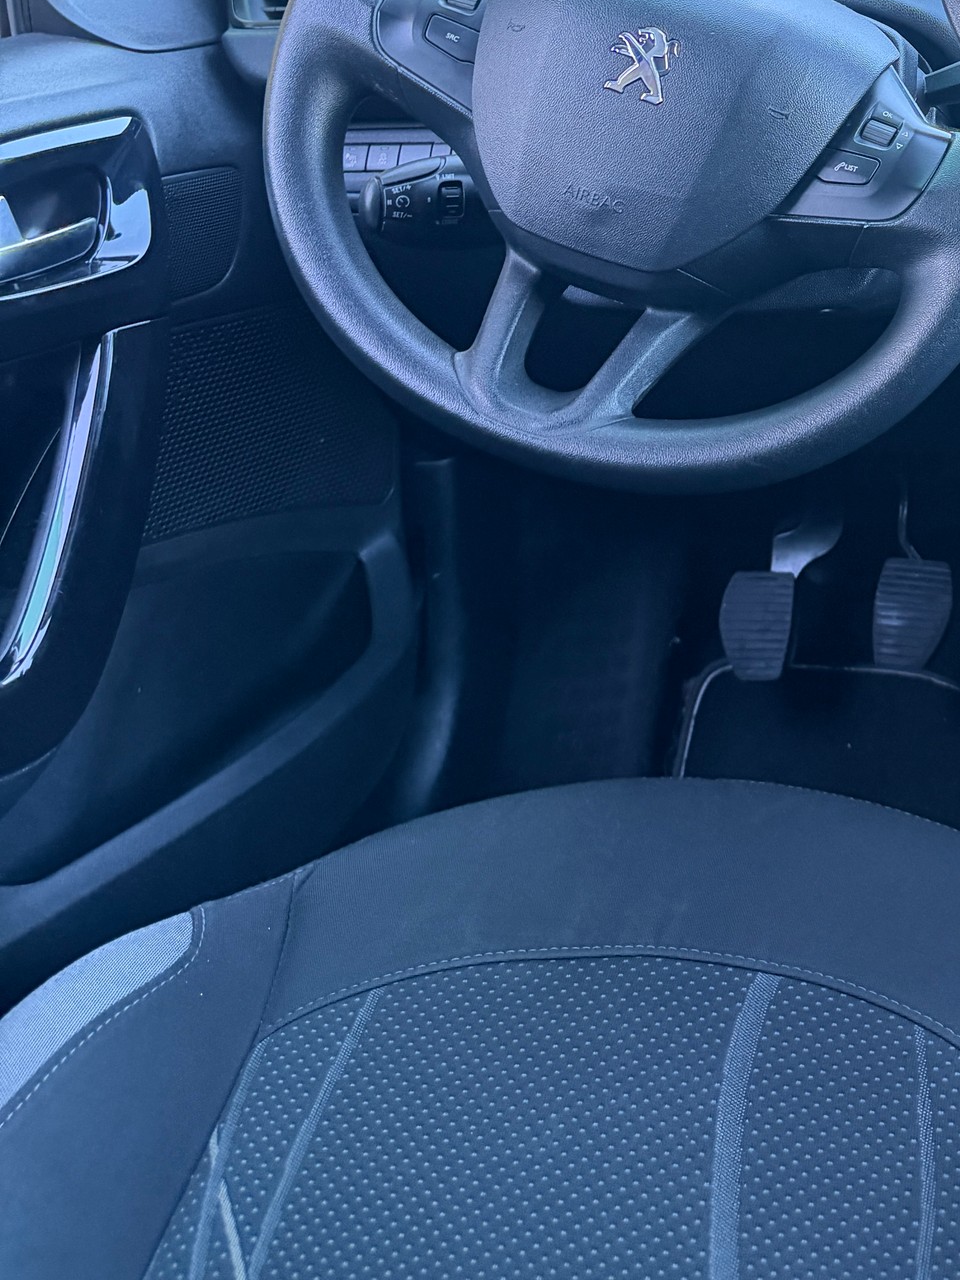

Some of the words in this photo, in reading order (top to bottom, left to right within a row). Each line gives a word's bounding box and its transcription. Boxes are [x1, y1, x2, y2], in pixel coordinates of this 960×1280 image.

[445, 32, 460, 43] SRC
[882, 110, 894, 119] OK
[561, 181, 625, 214] AIRBAG
